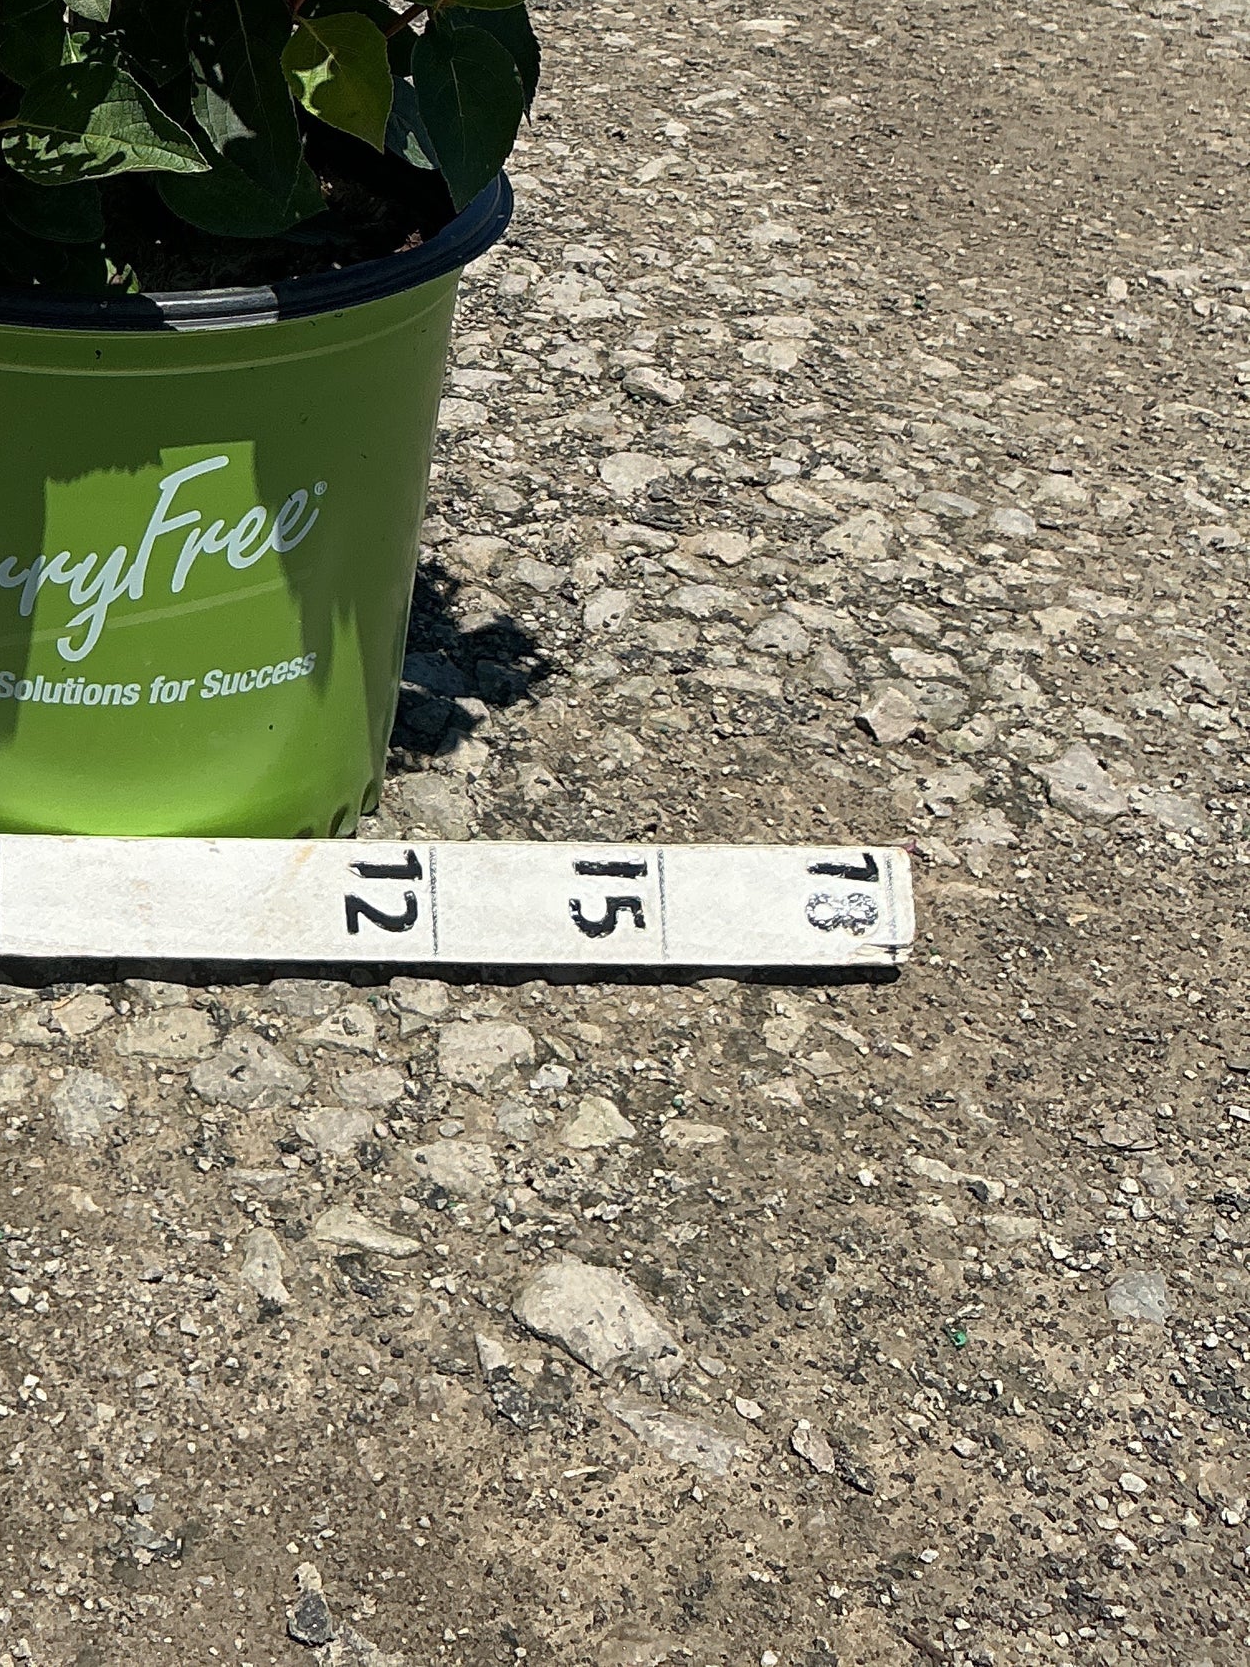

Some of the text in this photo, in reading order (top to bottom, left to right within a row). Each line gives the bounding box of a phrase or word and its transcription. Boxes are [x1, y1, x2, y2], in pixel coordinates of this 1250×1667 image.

[148, 675, 196, 705] for
[200, 651, 317, 699] Success
[344, 848, 423, 934] 12
[569, 858, 649, 939] 15
[805, 852, 879, 937] 18
